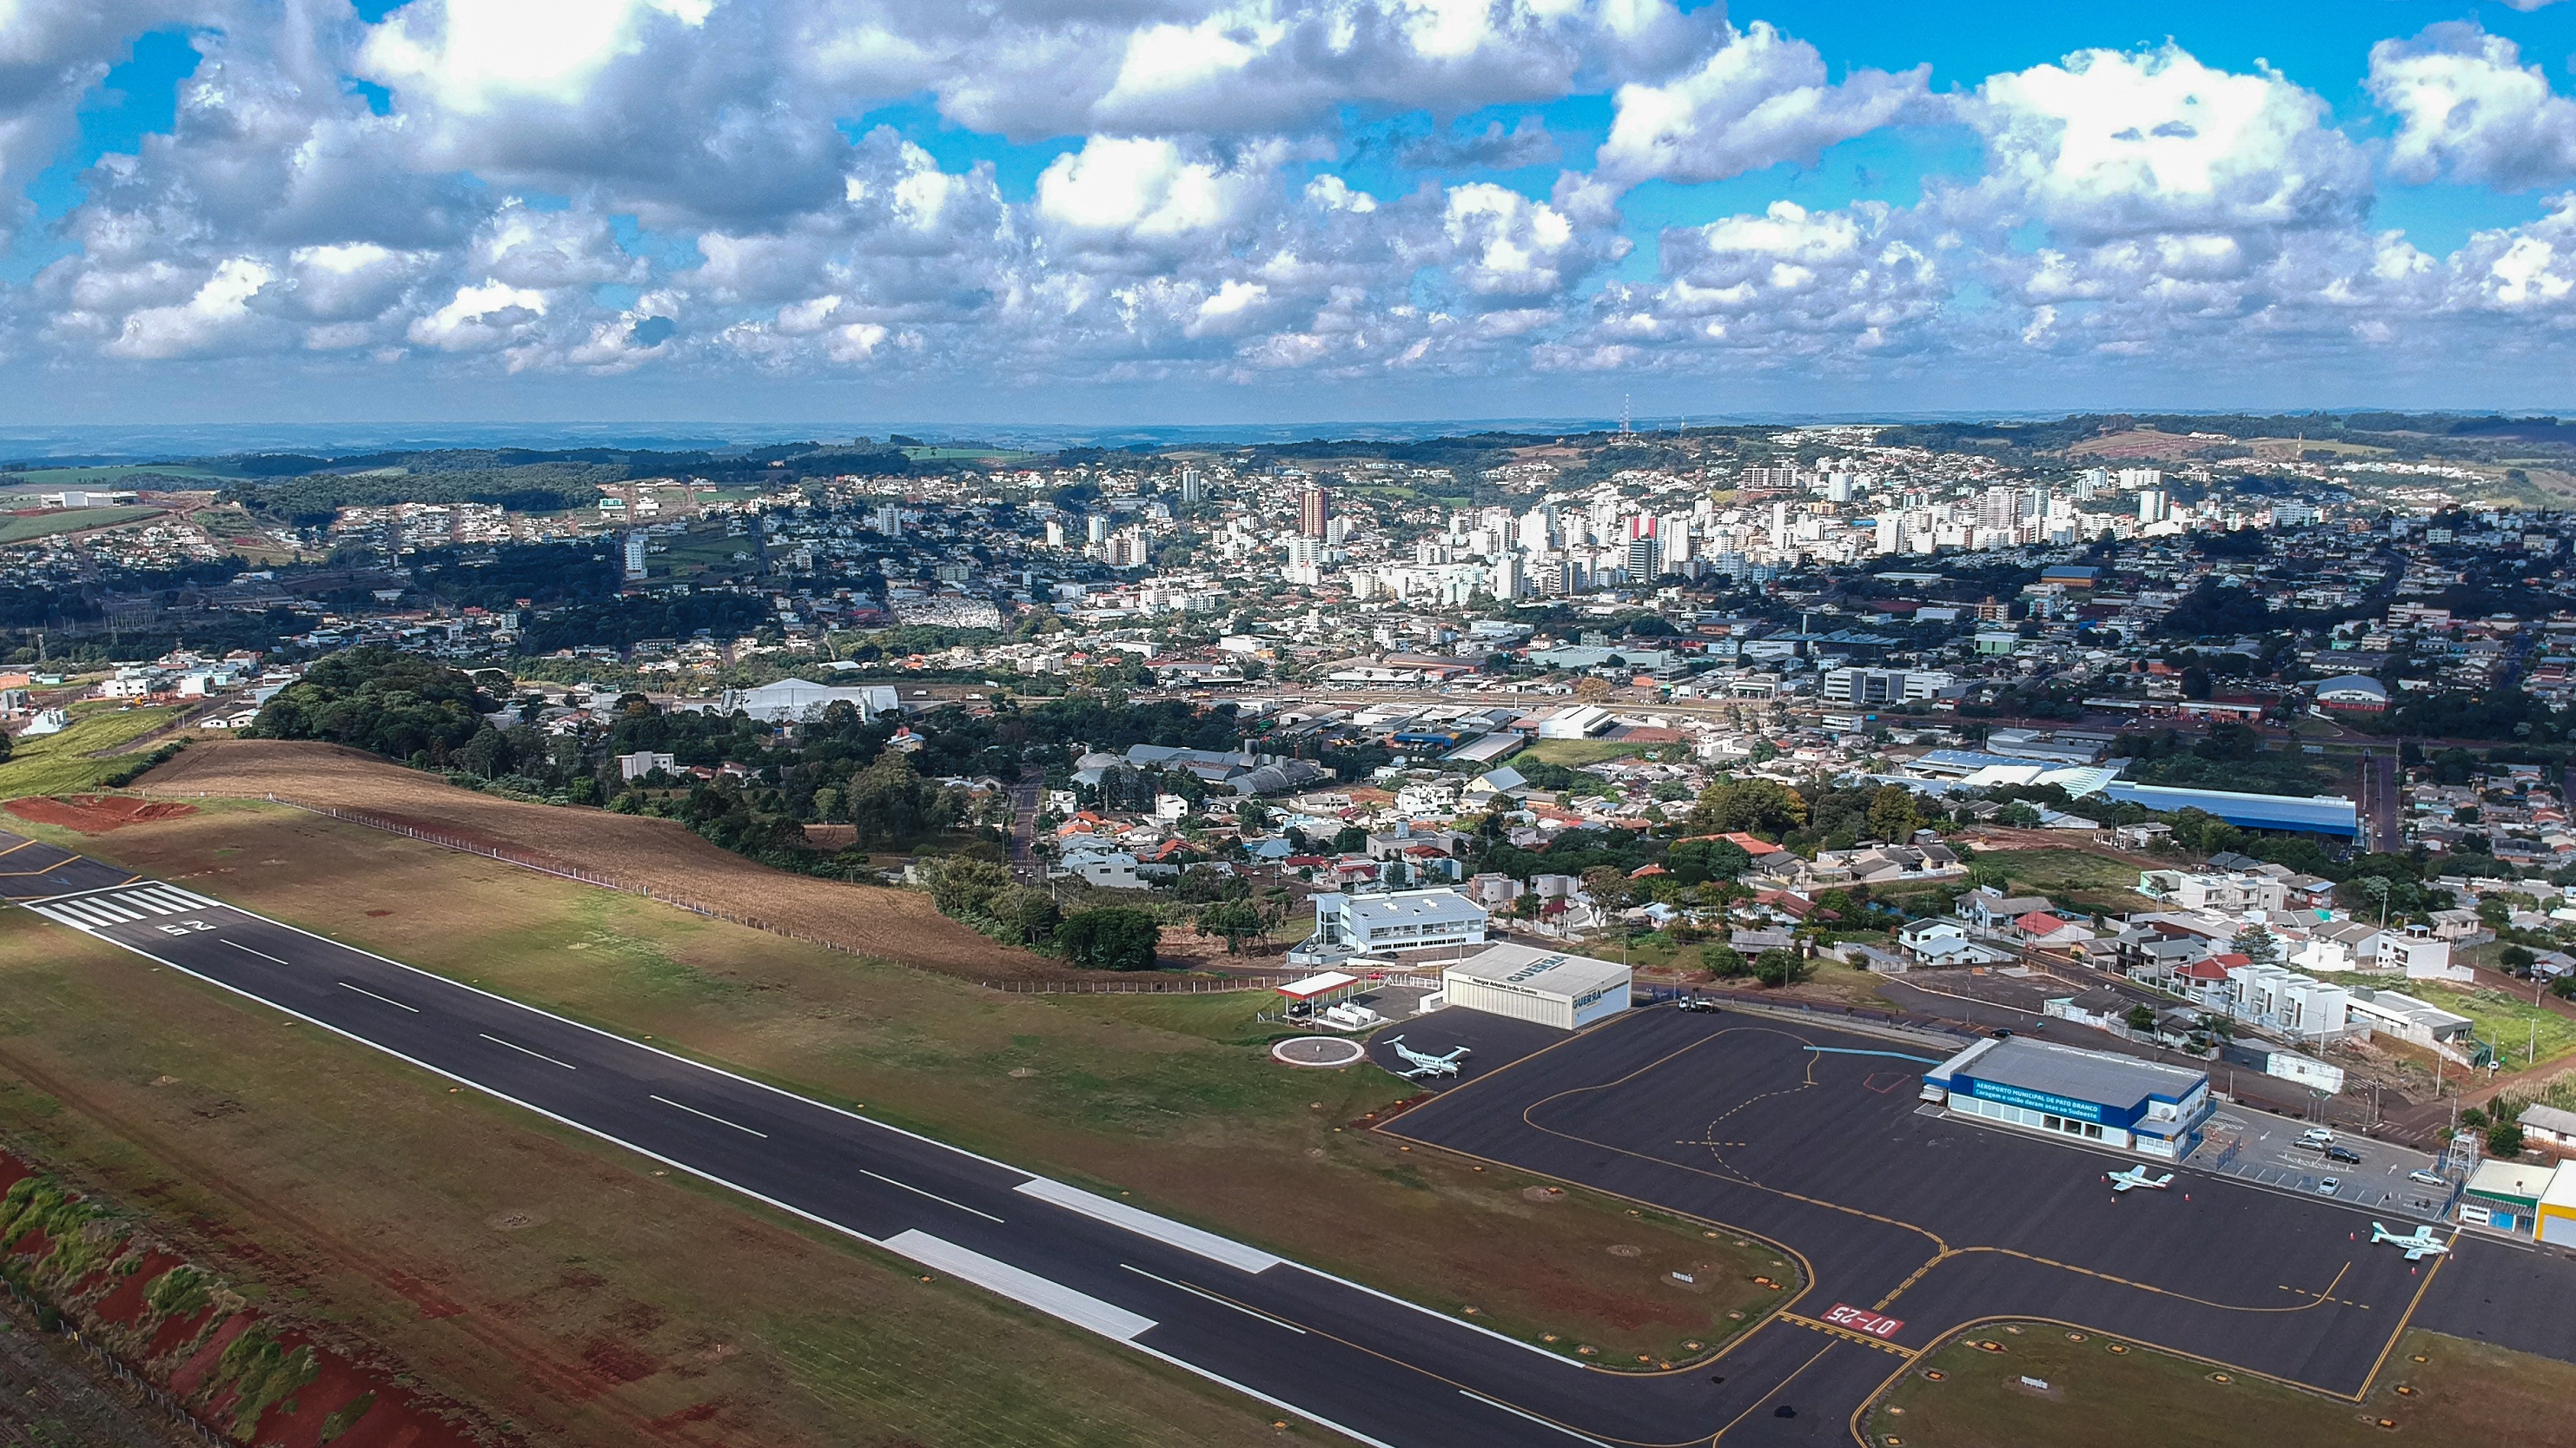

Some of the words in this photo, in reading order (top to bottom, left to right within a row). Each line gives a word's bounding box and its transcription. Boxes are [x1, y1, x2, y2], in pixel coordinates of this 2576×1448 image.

[1507, 955, 1570, 982] GUERRA
[1573, 989, 1602, 1009] GUERRA
[1976, 1082, 2011, 1094] AEROPORTO
[2012, 1091, 2044, 1102] MUNICIPAL
[2055, 1098, 2071, 1107] PATO
[2072, 1102, 2097, 1112] BRANCO
[1976, 1089, 2001, 1099] Coragem
[2007, 1095, 2023, 1104] união
[2024, 1098, 2044, 1108] deram
[2068, 1108, 2097, 1119] Sudoeste
[1827, 1306, 1897, 1335] 07-25
